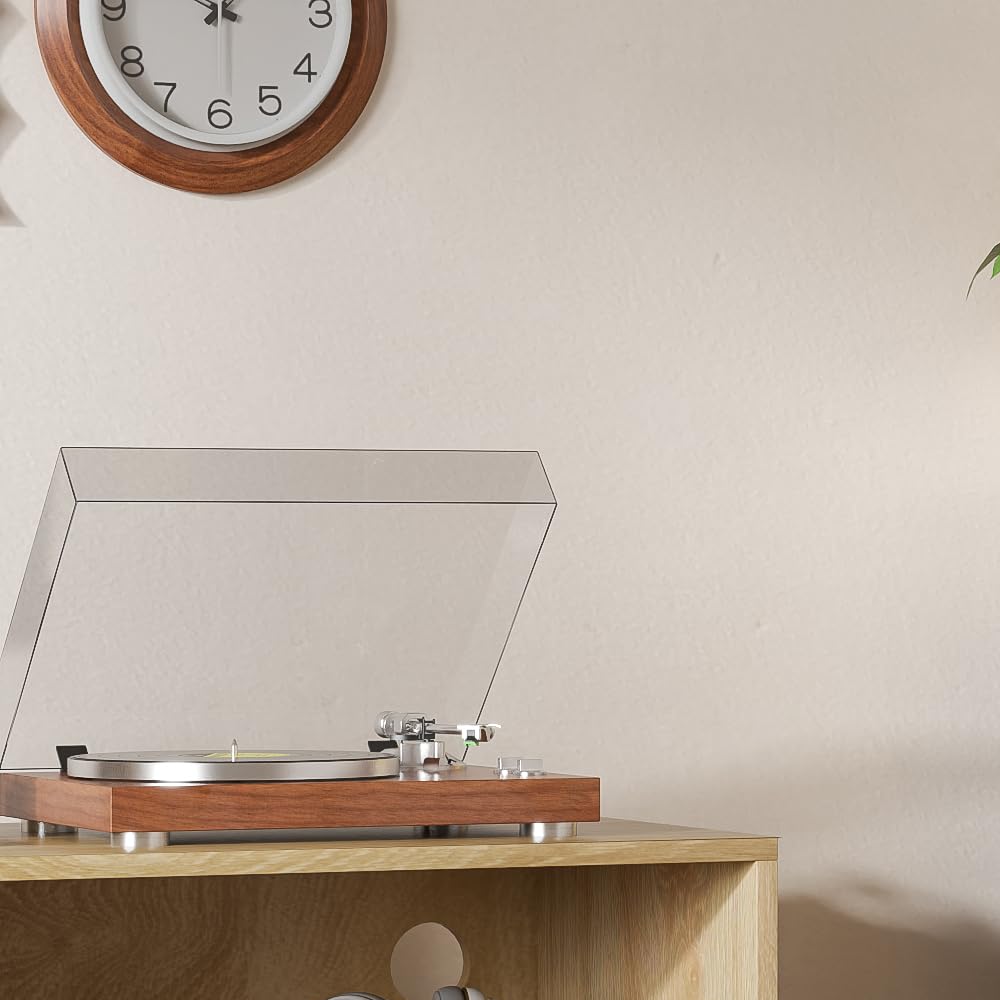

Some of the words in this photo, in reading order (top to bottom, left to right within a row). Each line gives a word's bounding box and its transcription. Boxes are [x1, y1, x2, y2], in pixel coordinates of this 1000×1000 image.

[103, 0, 126, 21] 9
[308, 0, 332, 28] 3
[121, 46, 144, 77] 8
[293, 53, 317, 83] 4
[153, 82, 177, 112] 7
[258, 86, 282, 116] 5
[208, 99, 232, 129] 6
